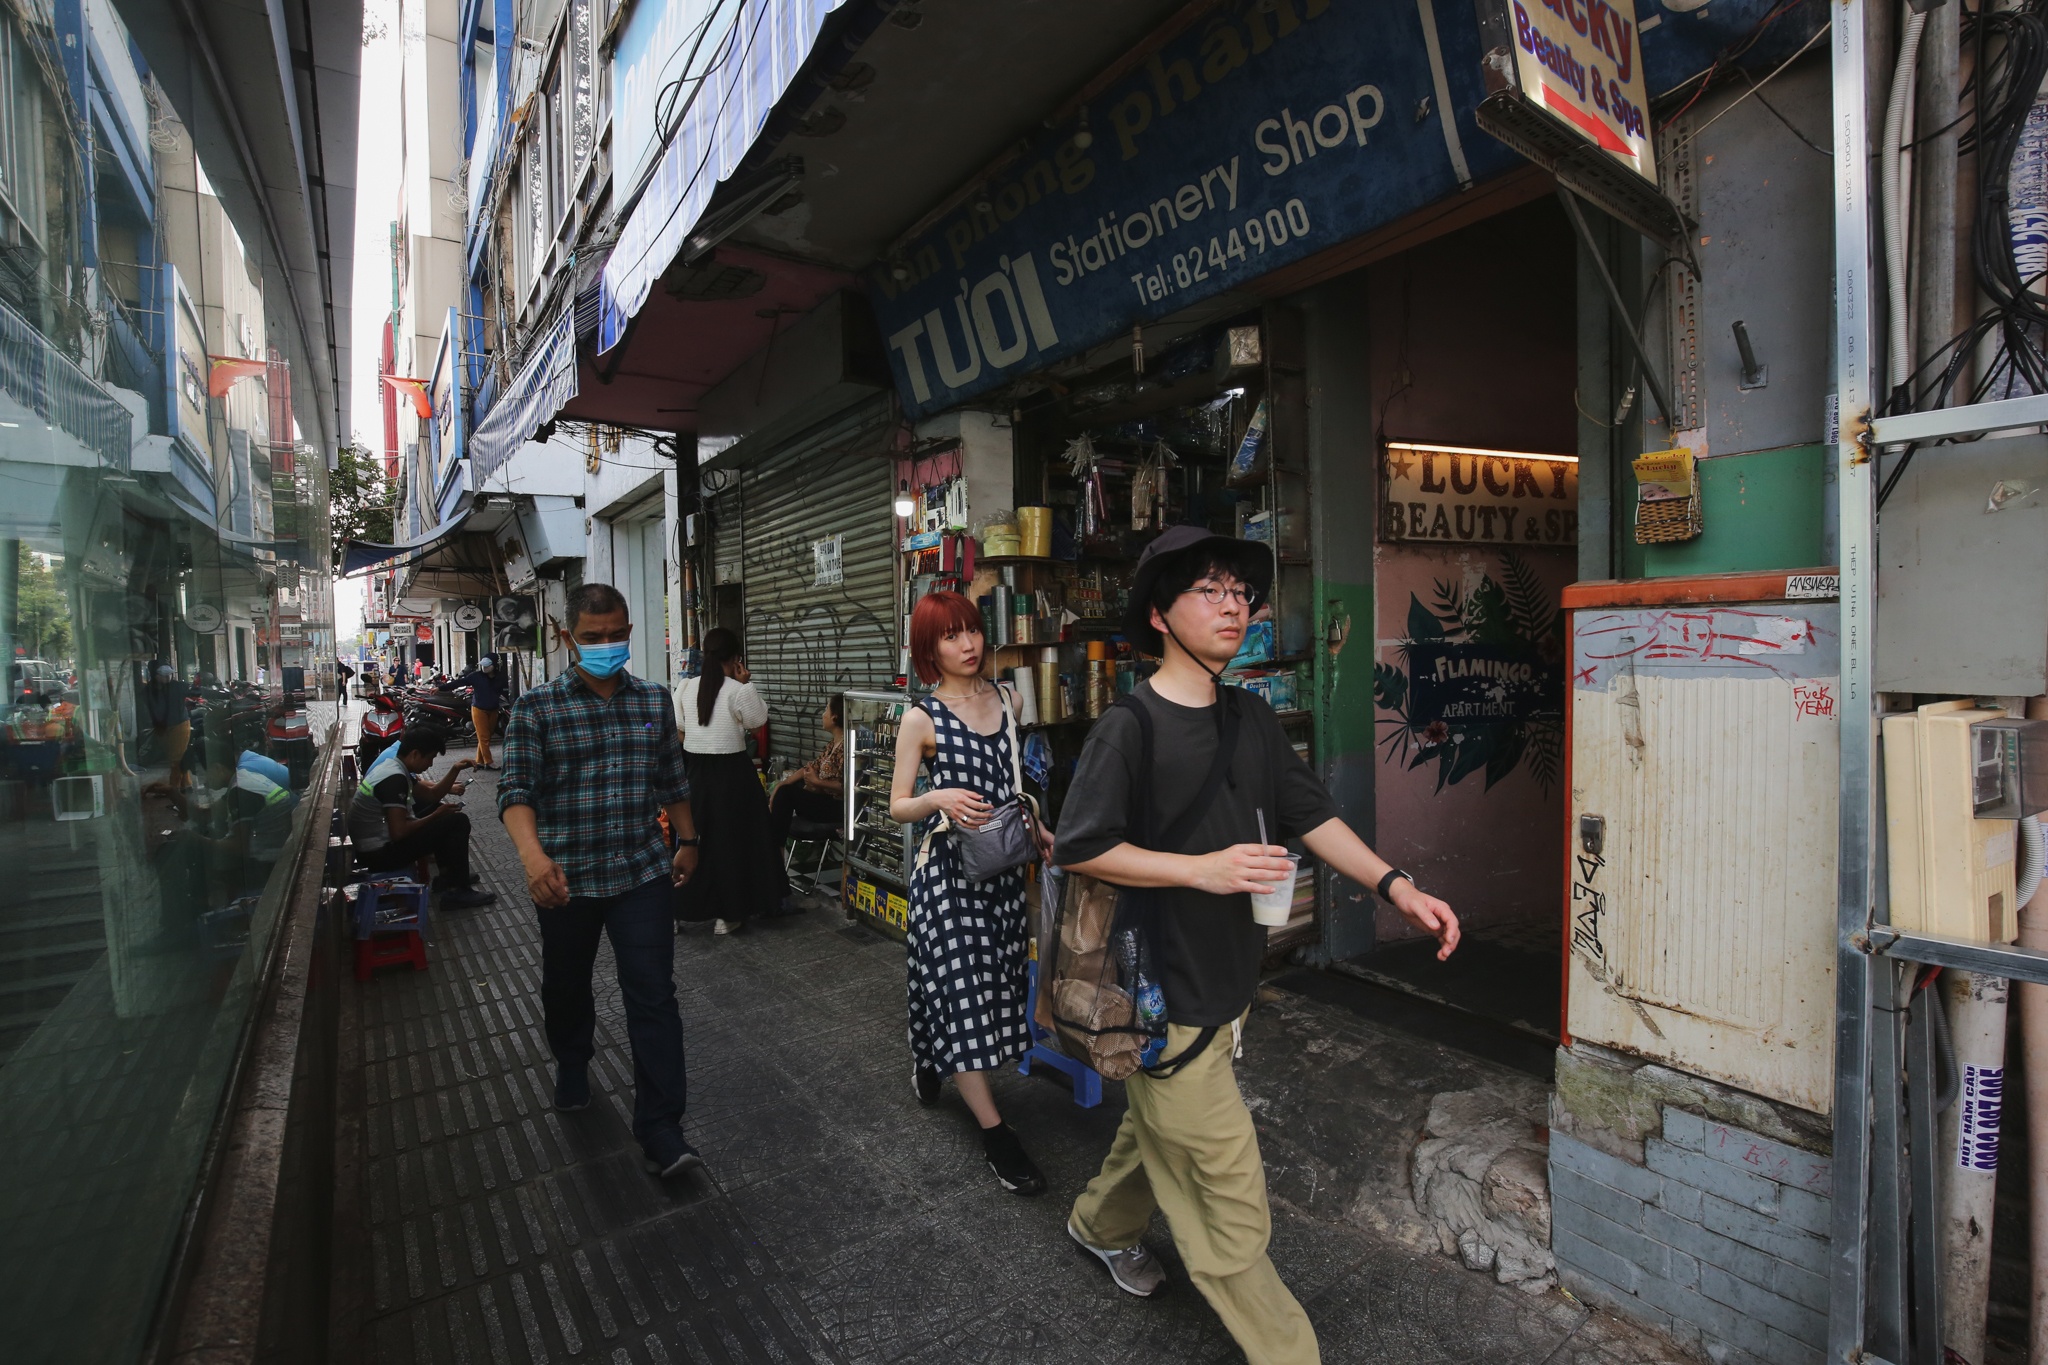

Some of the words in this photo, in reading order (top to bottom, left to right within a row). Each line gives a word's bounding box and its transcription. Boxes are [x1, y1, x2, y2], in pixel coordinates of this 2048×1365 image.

[1513, 0, 1587, 103] Beauty
[1591, 64, 1610, 115] &
[1609, 79, 1647, 141] Spa
[1050, 155, 1240, 287] Stationery
[1254, 84, 1385, 177] Shop
[1420, 450, 1570, 500] LUCKY
[1387, 502, 1519, 542] BEAUTY
[1526, 517, 1540, 541] &
[1544, 507, 1578, 542] SP
[1434, 656, 1532, 682] FLAMINGO
[1441, 700, 1515, 718] APARTMENT
[1960, 1136, 1971, 1167] HÚT
